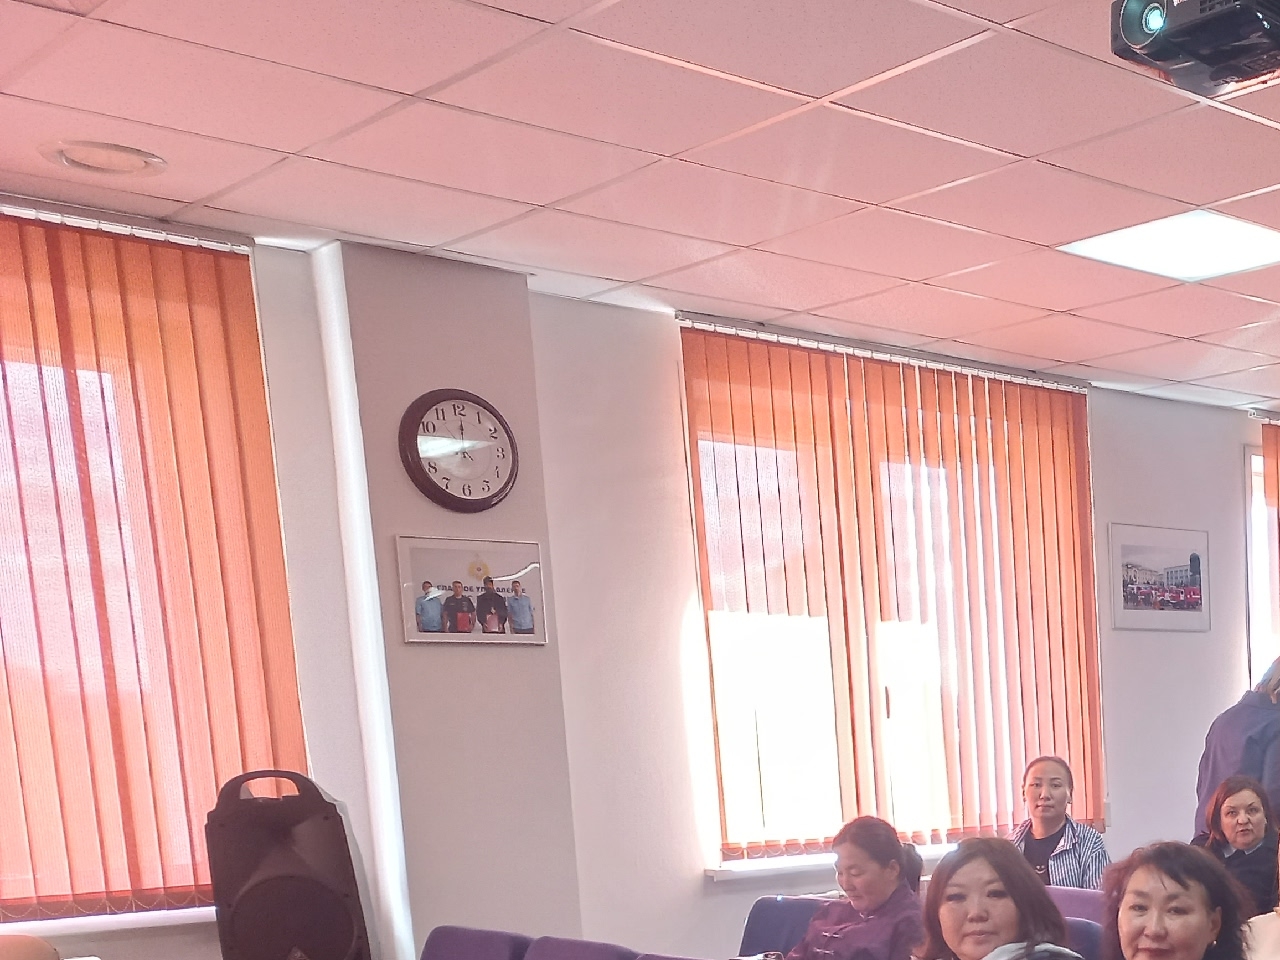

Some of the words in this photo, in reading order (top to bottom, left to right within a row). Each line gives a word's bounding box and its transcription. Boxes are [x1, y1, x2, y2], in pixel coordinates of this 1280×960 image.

[435, 408, 446, 421] 11
[452, 404, 466, 417] 12
[477, 411, 482, 424] 1
[421, 421, 436, 434] 10
[489, 427, 498, 440] 2
[496, 447, 505, 459] 3
[428, 461, 438, 474] 8
[441, 476, 451, 490] 7
[481, 480, 491, 492] 5
[462, 483, 472, 497] 6
